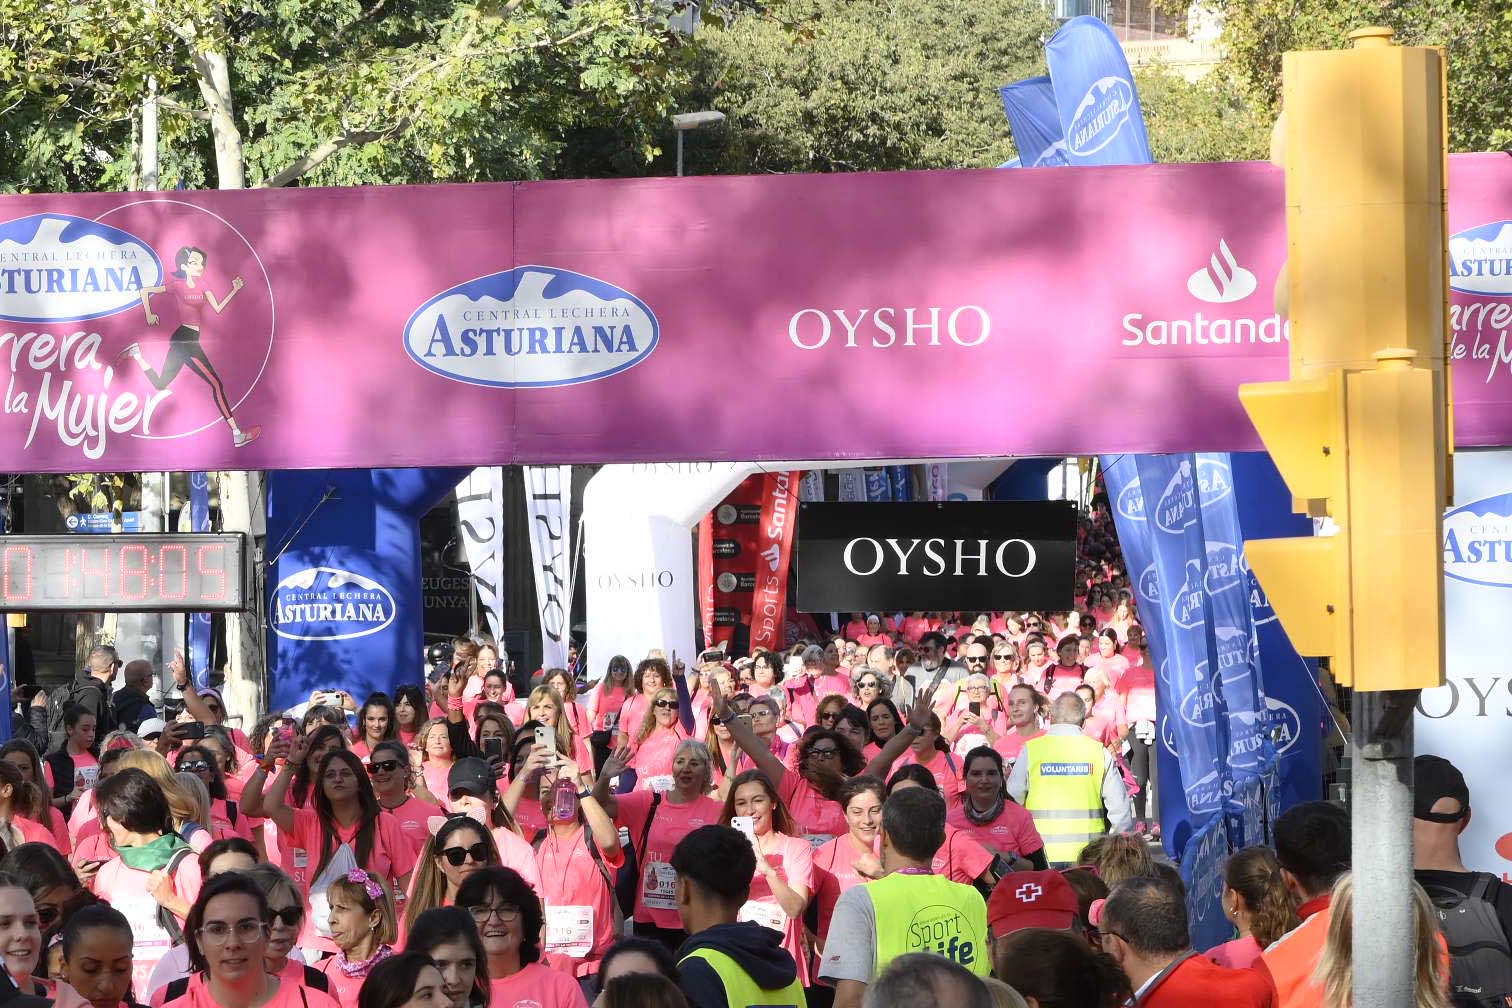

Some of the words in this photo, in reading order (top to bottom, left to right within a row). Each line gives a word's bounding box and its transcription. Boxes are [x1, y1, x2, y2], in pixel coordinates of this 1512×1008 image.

[65, 249, 138, 263] LECHERA
[463, 307, 543, 321] CENTRAL
[550, 305, 631, 319] LECHERA
[789, 305, 992, 350] OYSHO
[1450, 302, 1512, 332] arre
[423, 312, 639, 358] ASTURIANA
[1472, 332, 1490, 359] la
[3, 371, 29, 414] la
[24, 366, 172, 460] Mujer
[843, 537, 1037, 578] OYSHO
[285, 593, 328, 601] CENTRAL
[333, 592, 381, 600] LECHERA
[754, 575, 779, 642] Sports
[274, 601, 386, 625] ASTURIANA
[1415, 677, 1512, 719] OY
[1041, 765, 1089, 774] VOLUNTARIS
[659, 881, 676, 889] 016
[911, 913, 961, 951] Sport
[925, 936, 974, 965] ife
